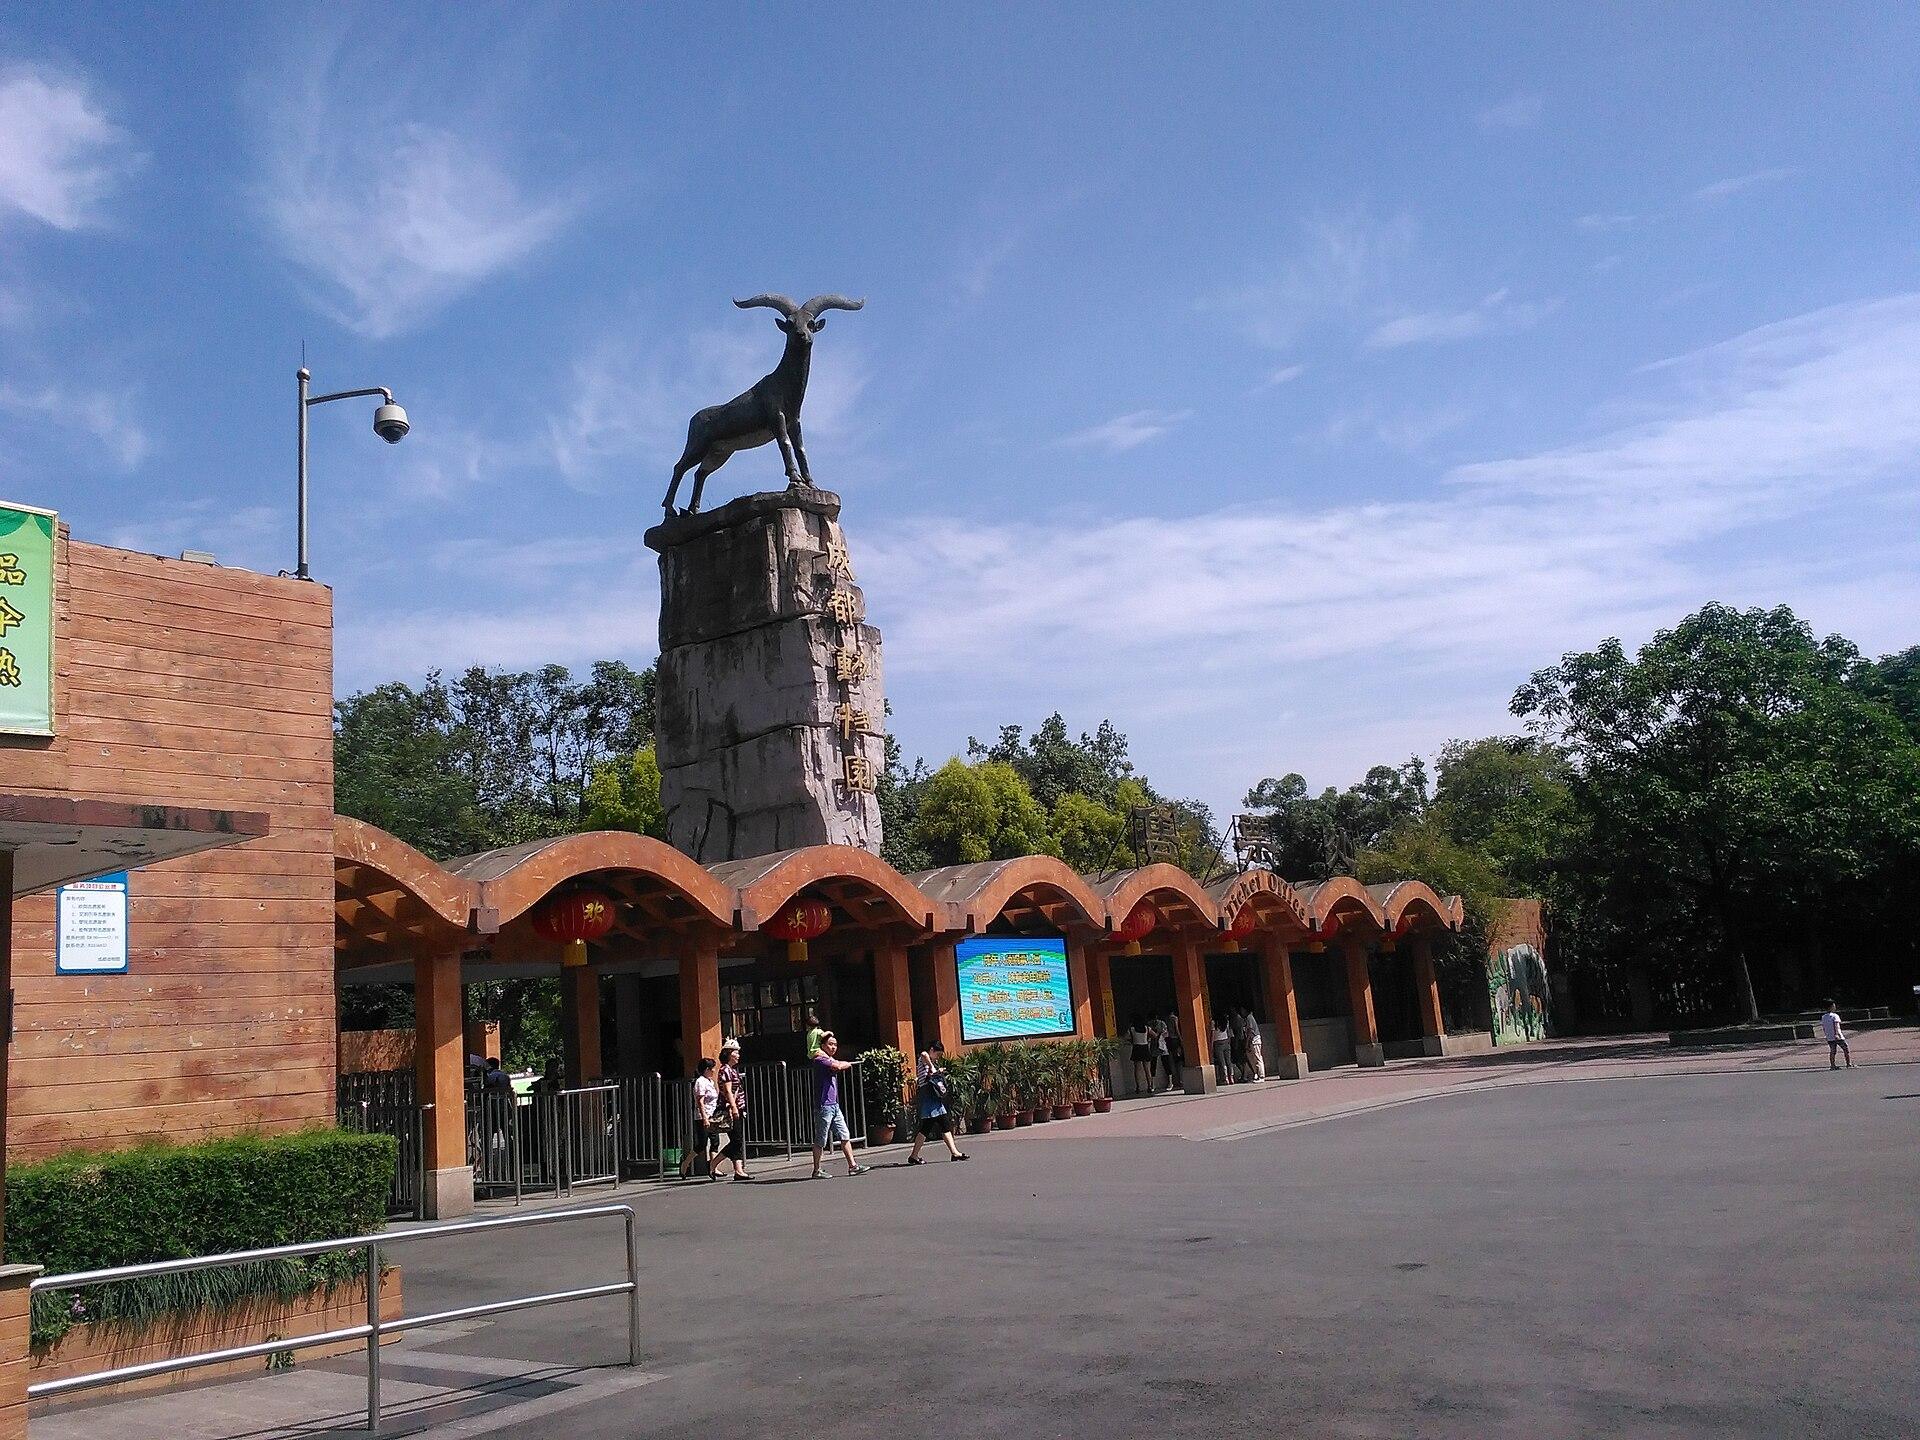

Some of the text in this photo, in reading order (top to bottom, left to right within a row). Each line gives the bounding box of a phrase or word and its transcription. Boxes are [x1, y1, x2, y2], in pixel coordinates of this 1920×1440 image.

[0, 552, 28, 586] 品
[1224, 872, 1305, 920] Ticket Office
